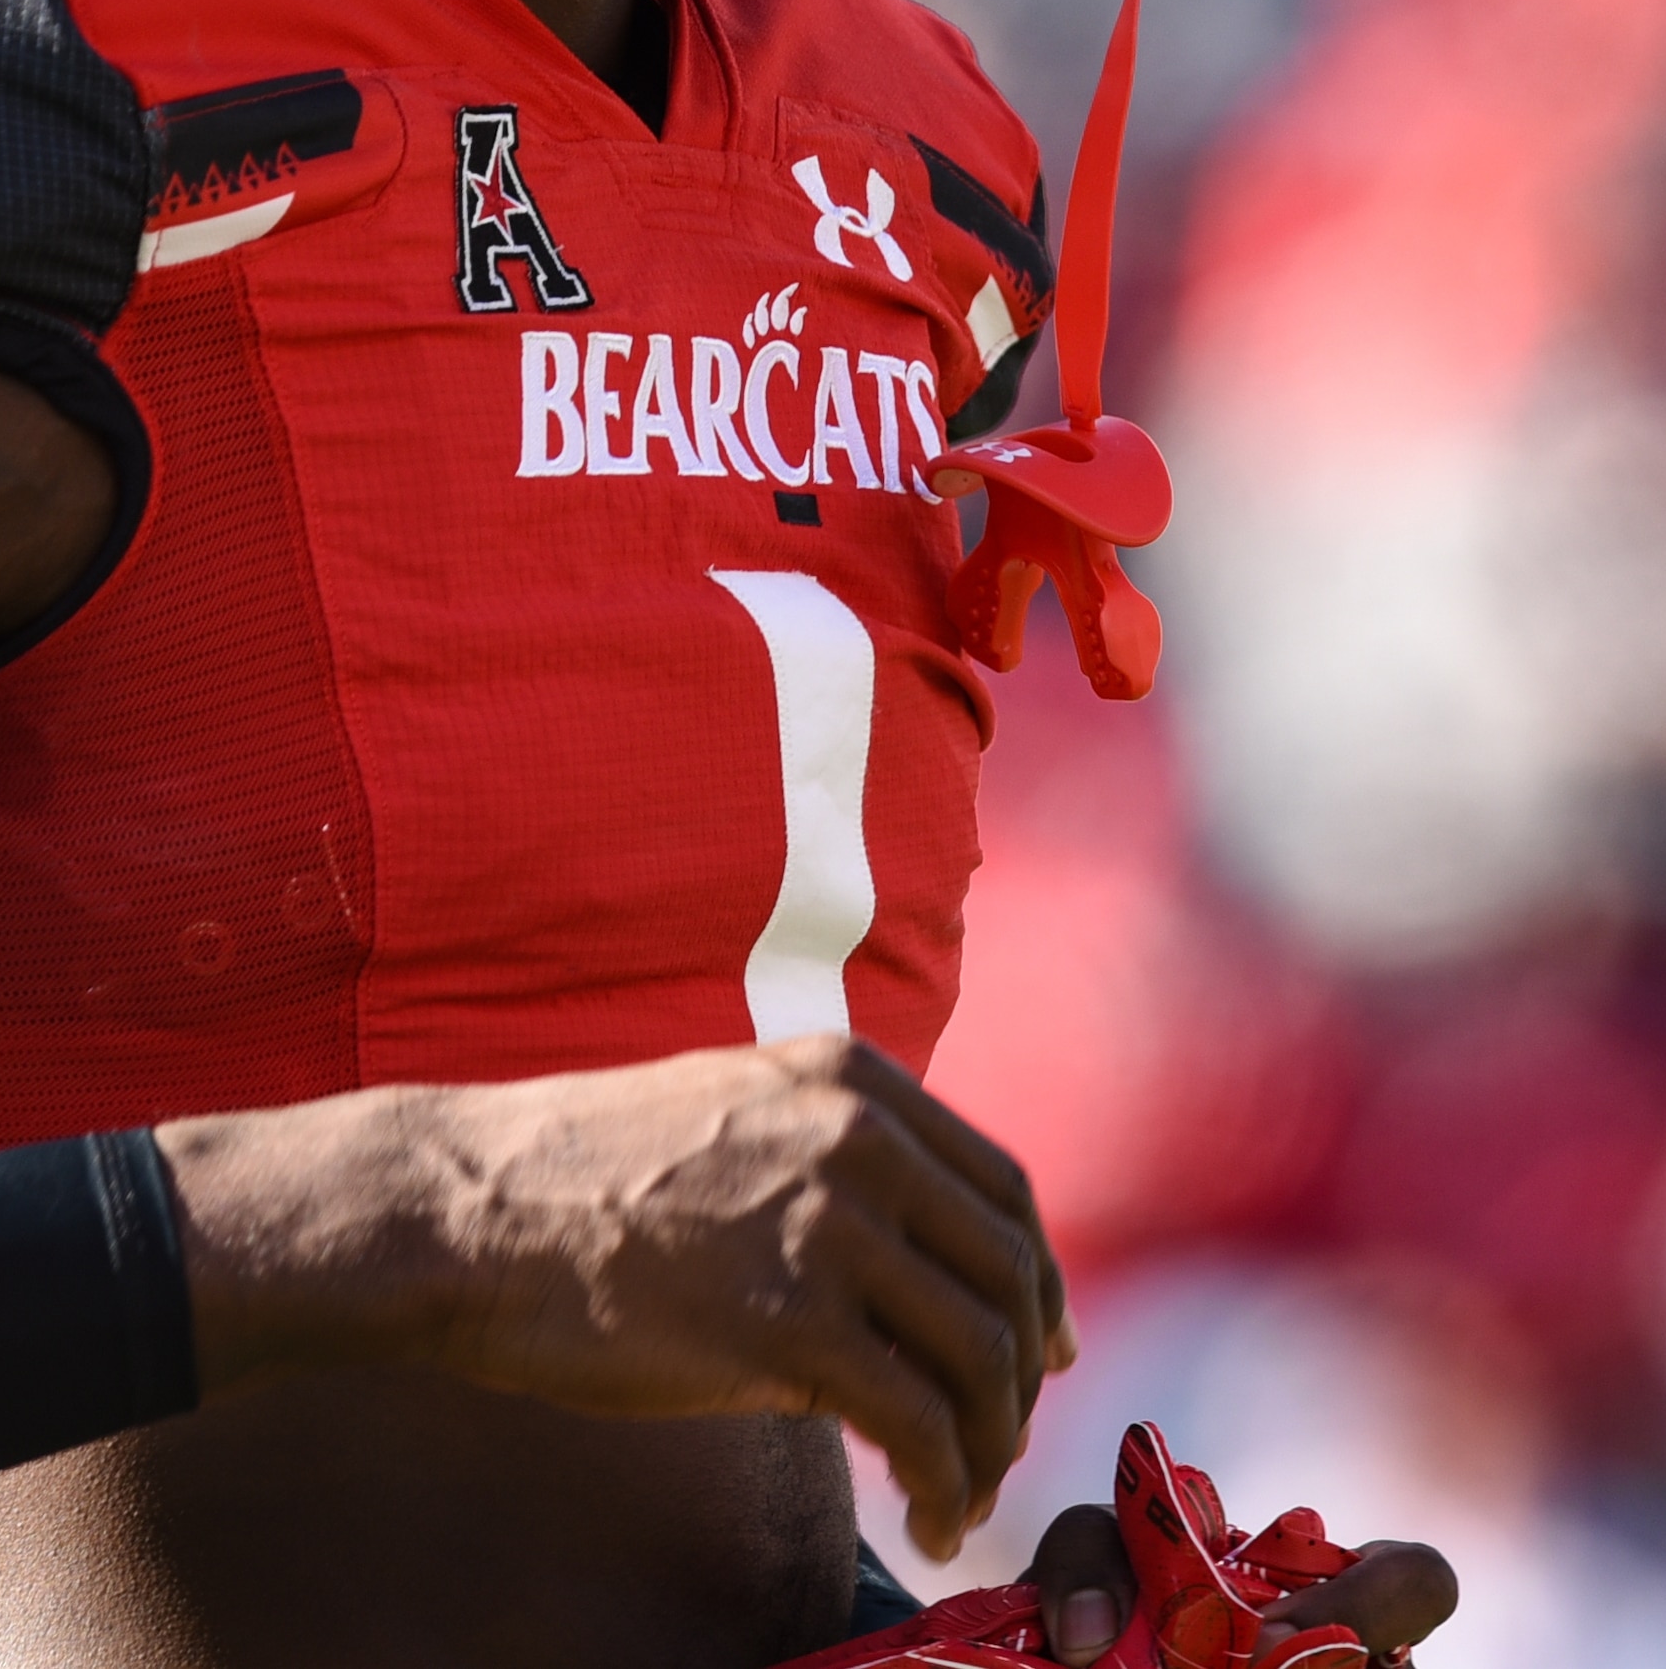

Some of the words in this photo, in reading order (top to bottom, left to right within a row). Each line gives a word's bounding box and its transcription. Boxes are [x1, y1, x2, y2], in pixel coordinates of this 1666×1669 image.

[454, 103, 594, 312] A
[516, 331, 944, 505] BEARCATS
[706, 566, 876, 1048] 1
